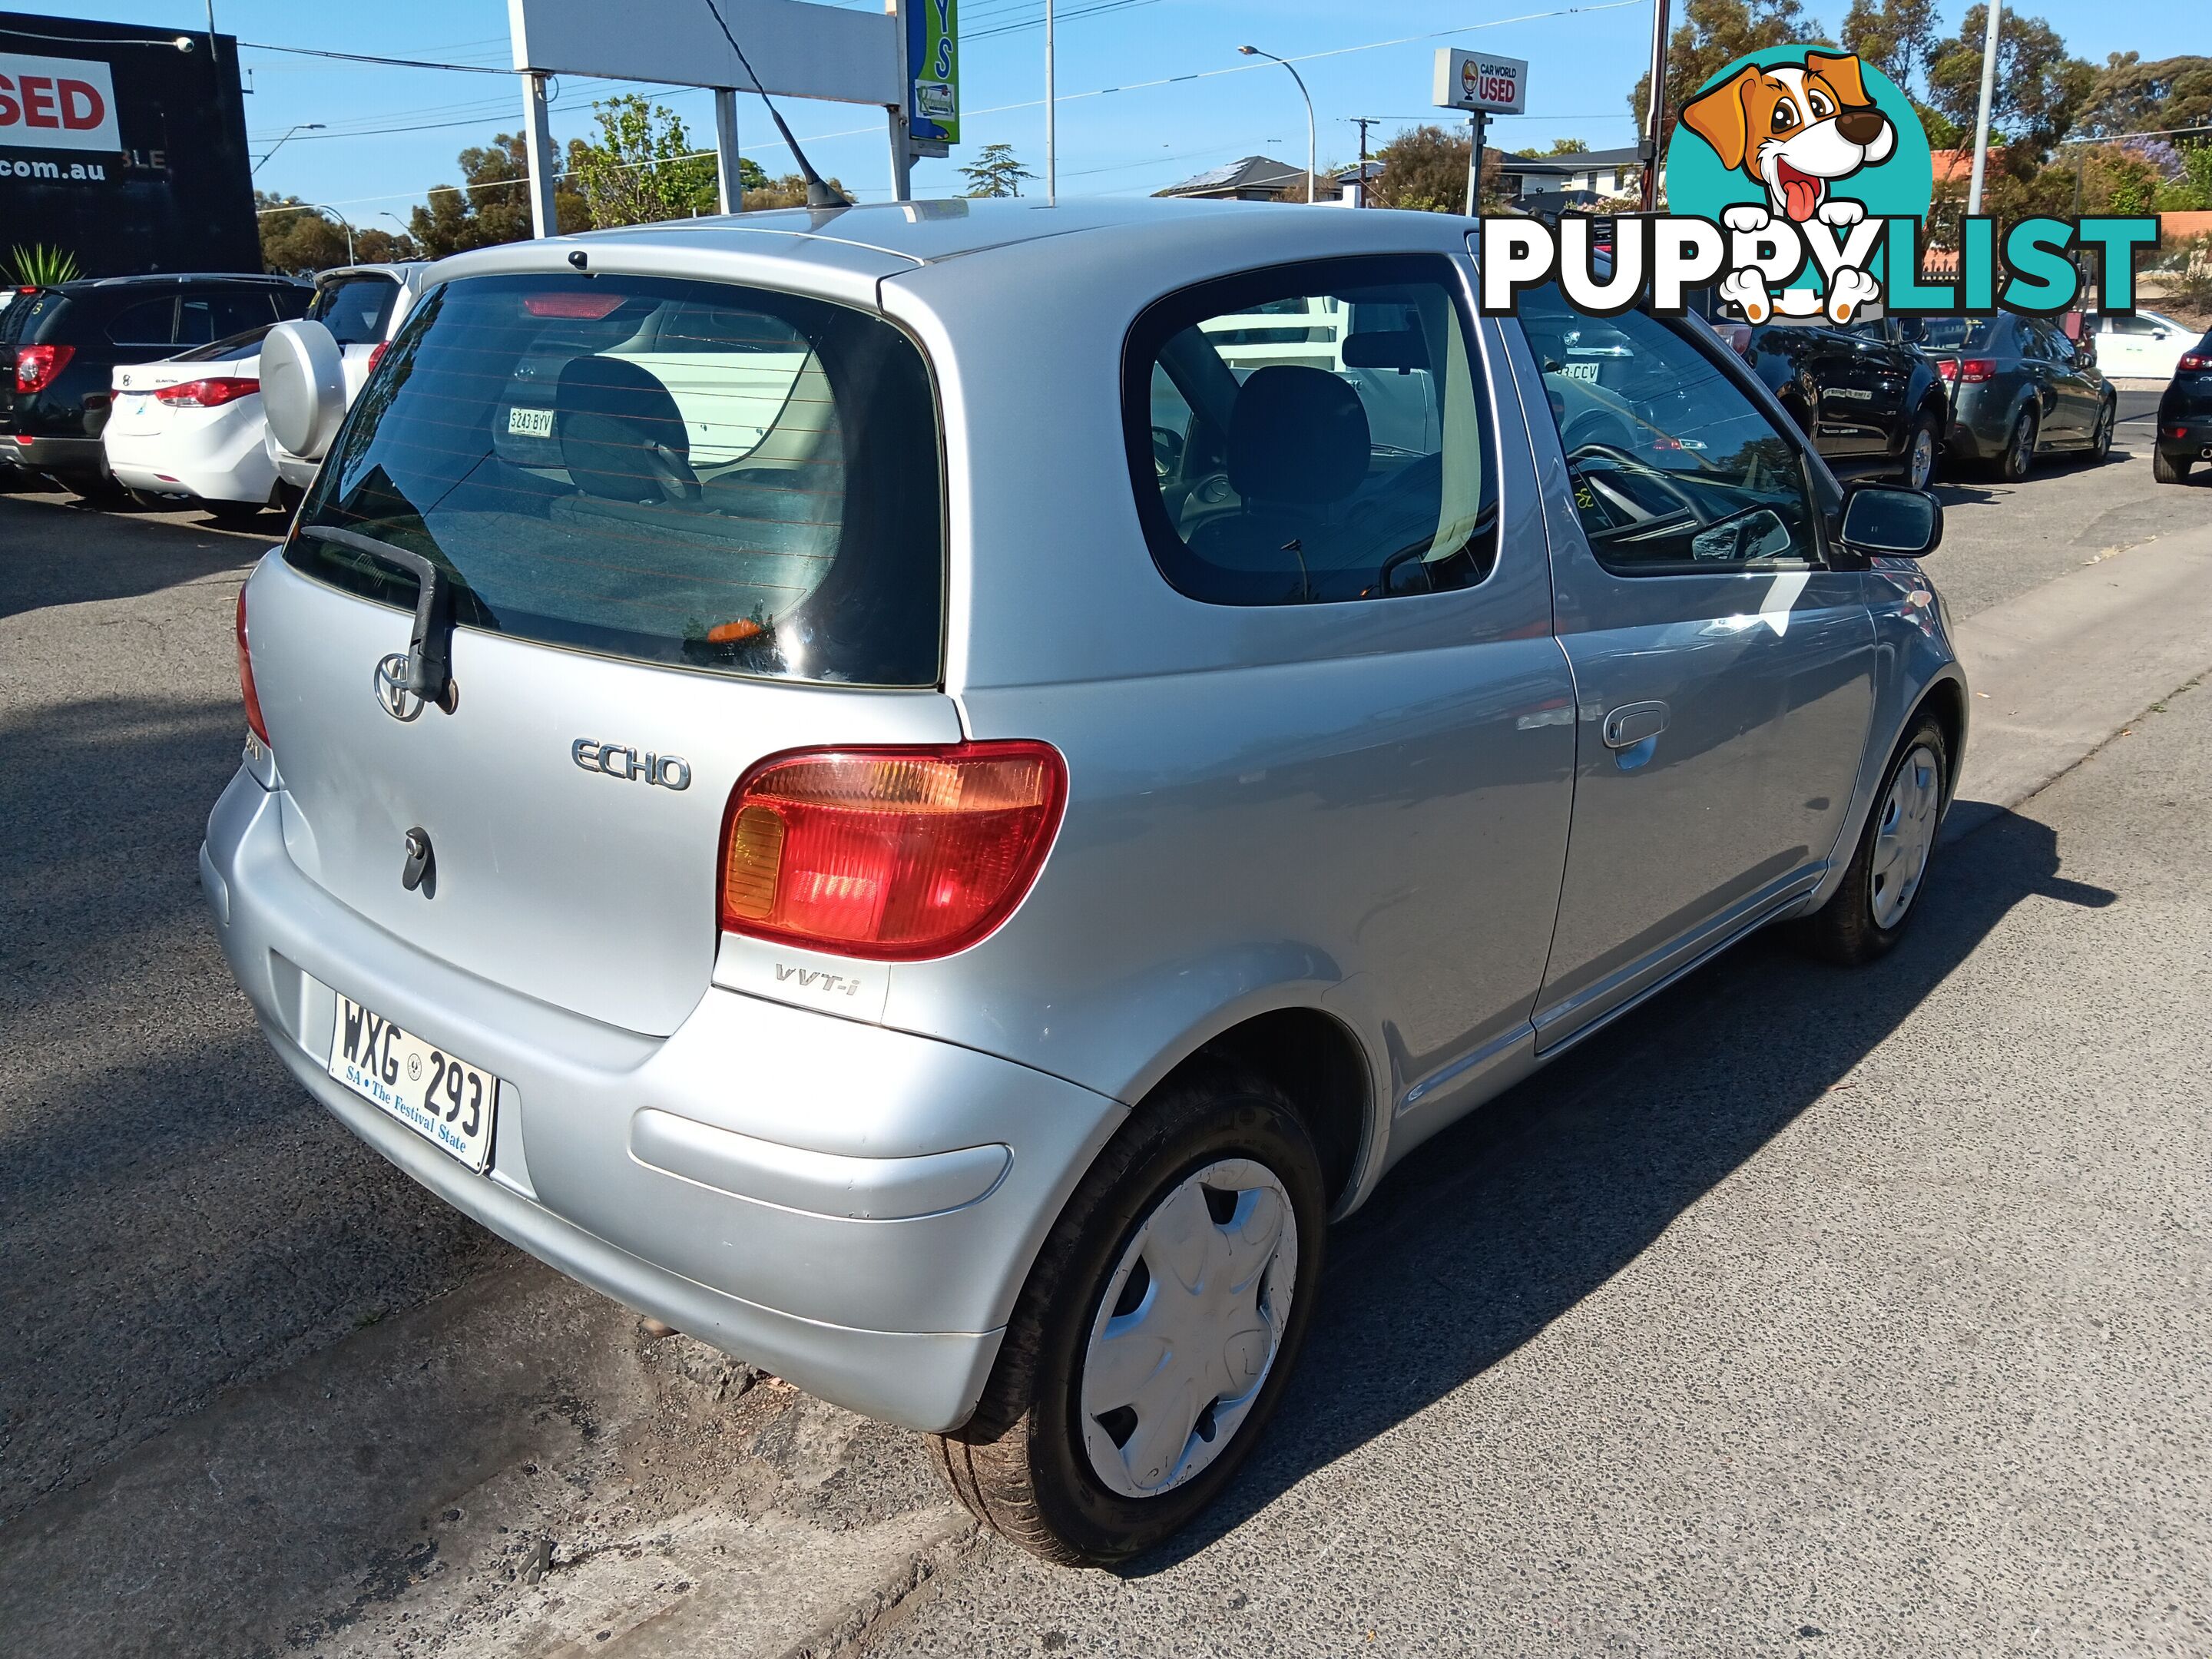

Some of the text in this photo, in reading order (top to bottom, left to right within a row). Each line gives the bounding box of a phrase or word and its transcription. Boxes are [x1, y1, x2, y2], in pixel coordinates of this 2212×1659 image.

[1479, 76, 1515, 102] USED
[1480, 64, 1516, 78] CAR WORLD
[571, 737, 691, 791] ECHO
[776, 963, 861, 996] VVT-i
[343, 998, 482, 1137] WXG 293
[346, 1065, 467, 1154] SA The Festival State
